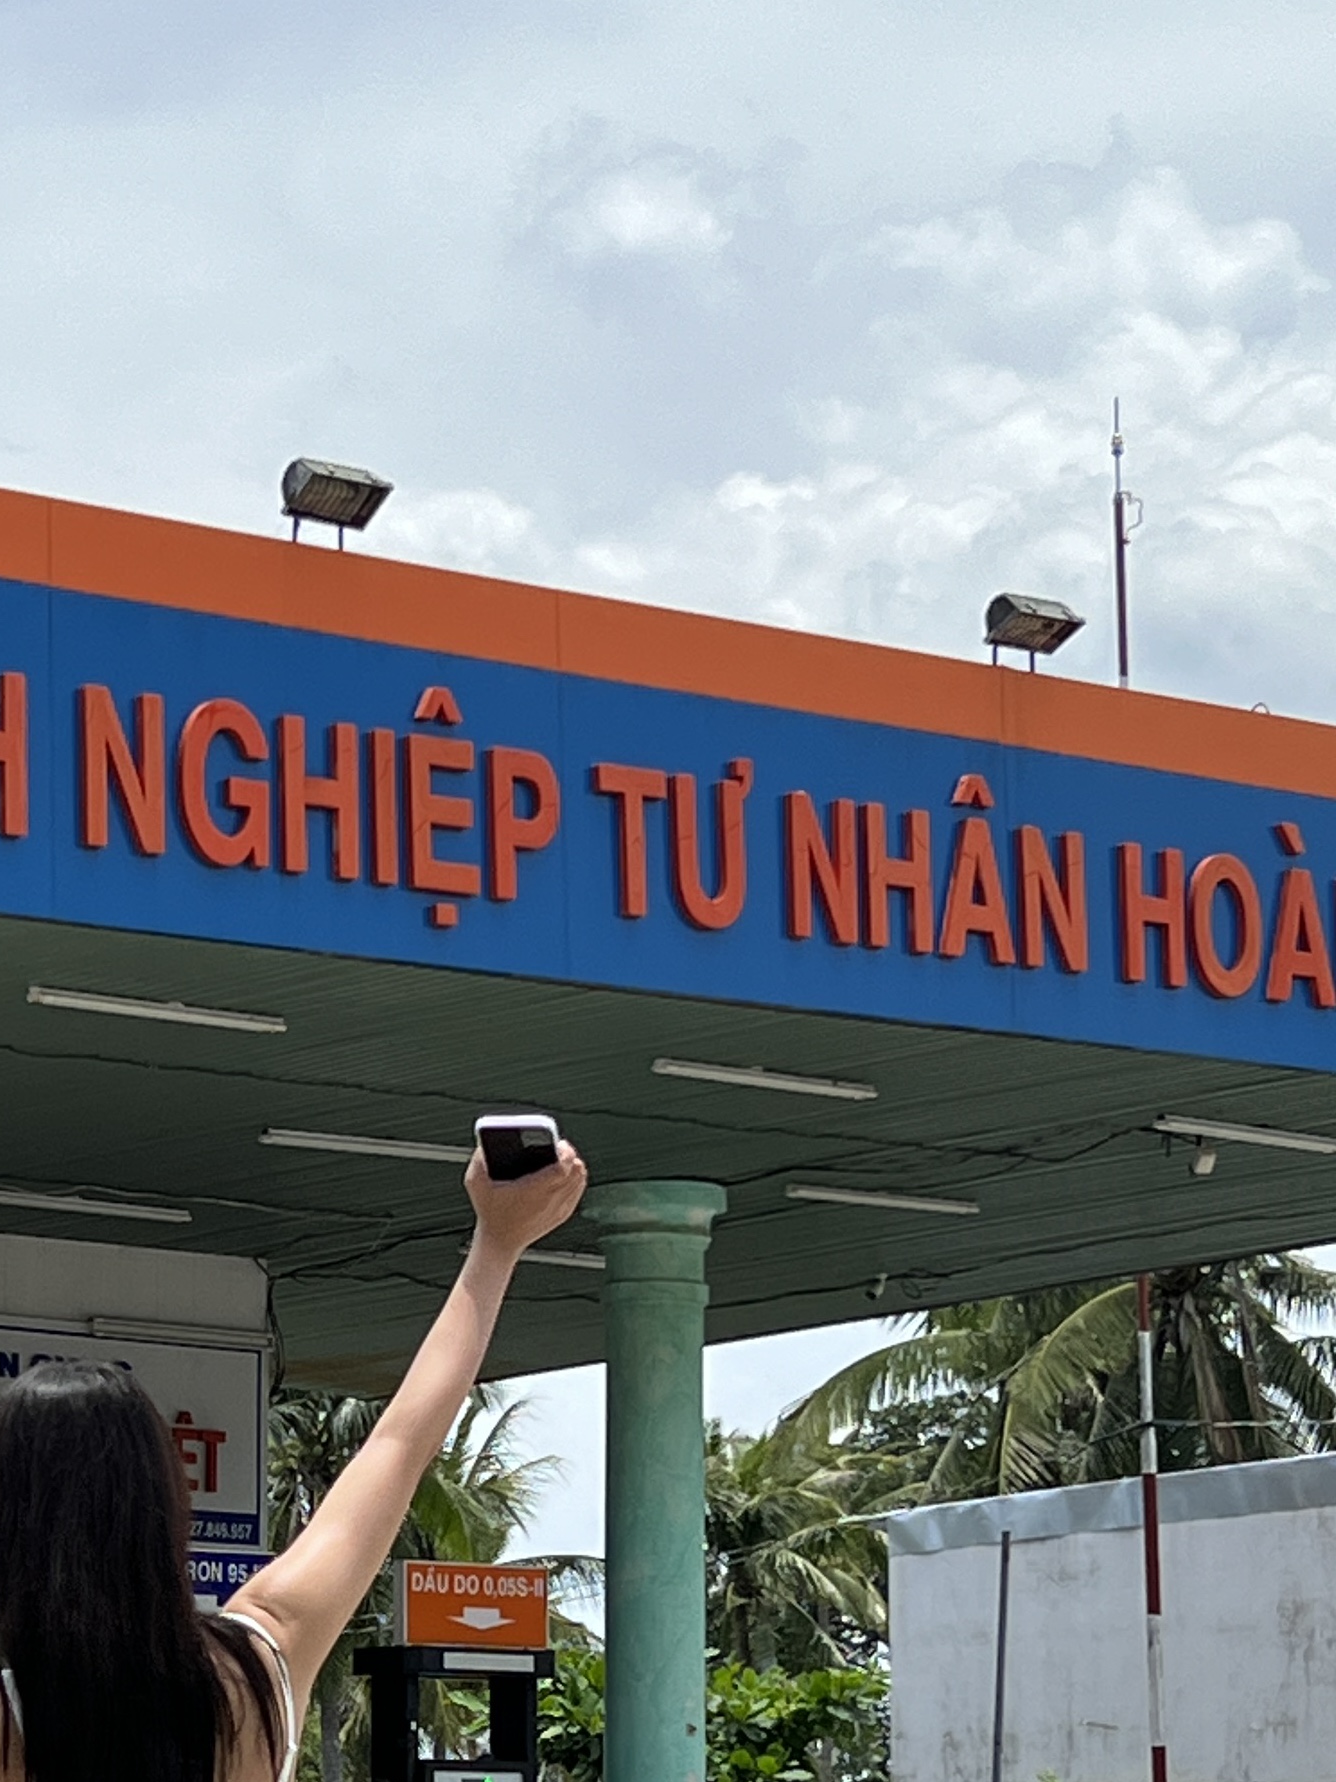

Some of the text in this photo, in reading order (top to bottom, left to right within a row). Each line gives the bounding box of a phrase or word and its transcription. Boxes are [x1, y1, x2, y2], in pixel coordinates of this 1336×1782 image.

[75, 684, 560, 928] NGHIỆP
[592, 757, 753, 930] TƯ
[785, 774, 1088, 973] NHÂN
[1117, 821, 1336, 1008] HOÀ
[453, 1574, 480, 1596] DO
